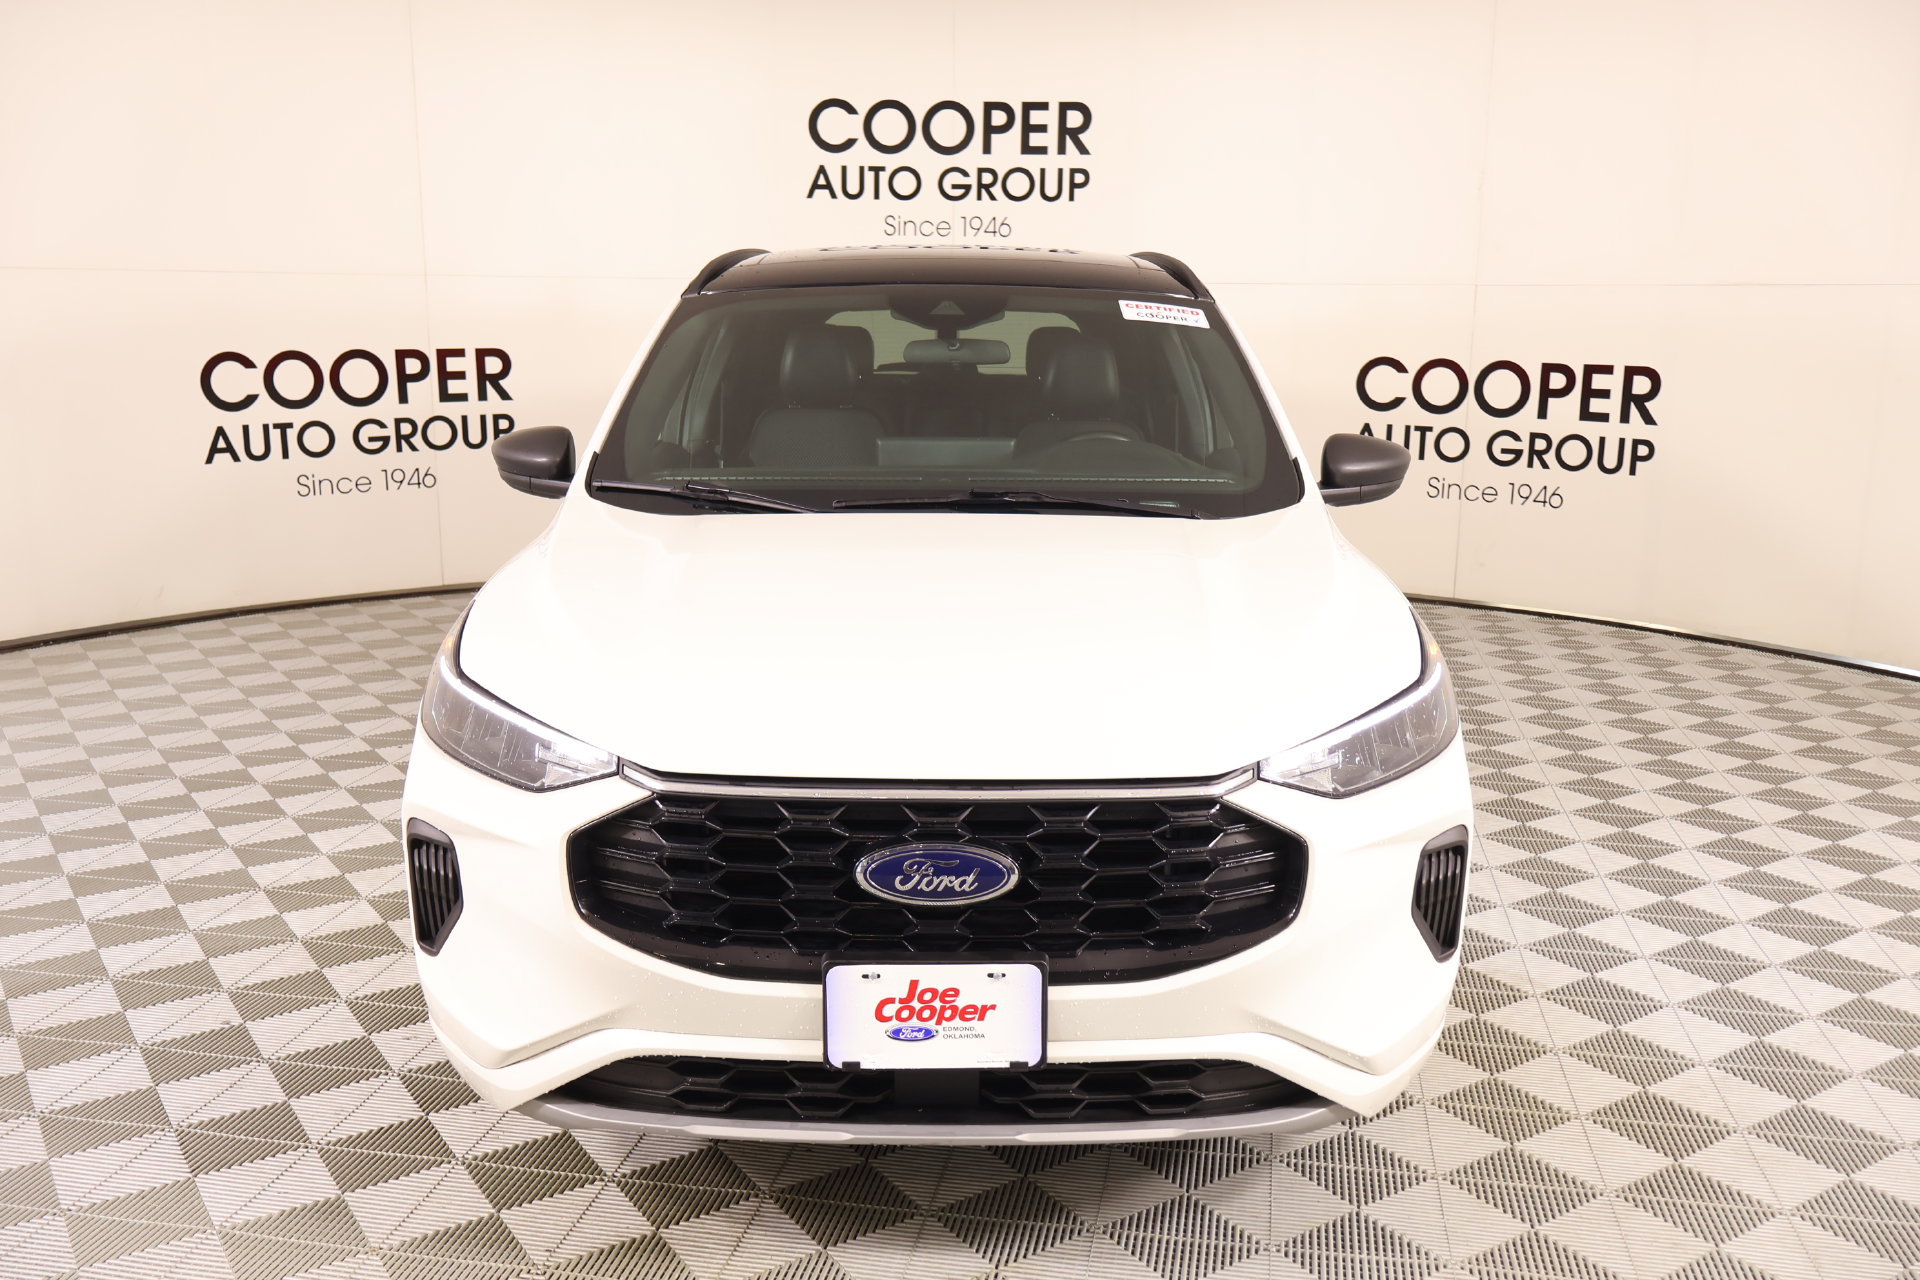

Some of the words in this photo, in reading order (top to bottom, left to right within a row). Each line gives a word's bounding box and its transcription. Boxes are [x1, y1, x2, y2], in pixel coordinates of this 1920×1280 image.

[808, 98, 1092, 155] COOPER
[806, 165, 922, 201] AUTO
[938, 166, 1090, 202] GROUP
[883, 214, 951, 237] Since
[960, 215, 1012, 238] 1946
[1125, 303, 1200, 316] CERTIFIED
[1136, 311, 1188, 322] COOPER
[200, 347, 514, 412] COOPER
[1356, 356, 1662, 426] COOPER
[204, 420, 336, 465] AUTO
[352, 413, 515, 455] GROUP
[1486, 429, 1656, 477] GROUP
[296, 474, 372, 497] Since
[381, 466, 437, 491] 1946
[1426, 476, 1499, 503] Since
[1508, 482, 1564, 509] 1946
[894, 857, 981, 892] Ford
[898, 979, 960, 1005] Joe
[874, 997, 997, 1026] Cooper
[899, 1027, 926, 1039] Ford
